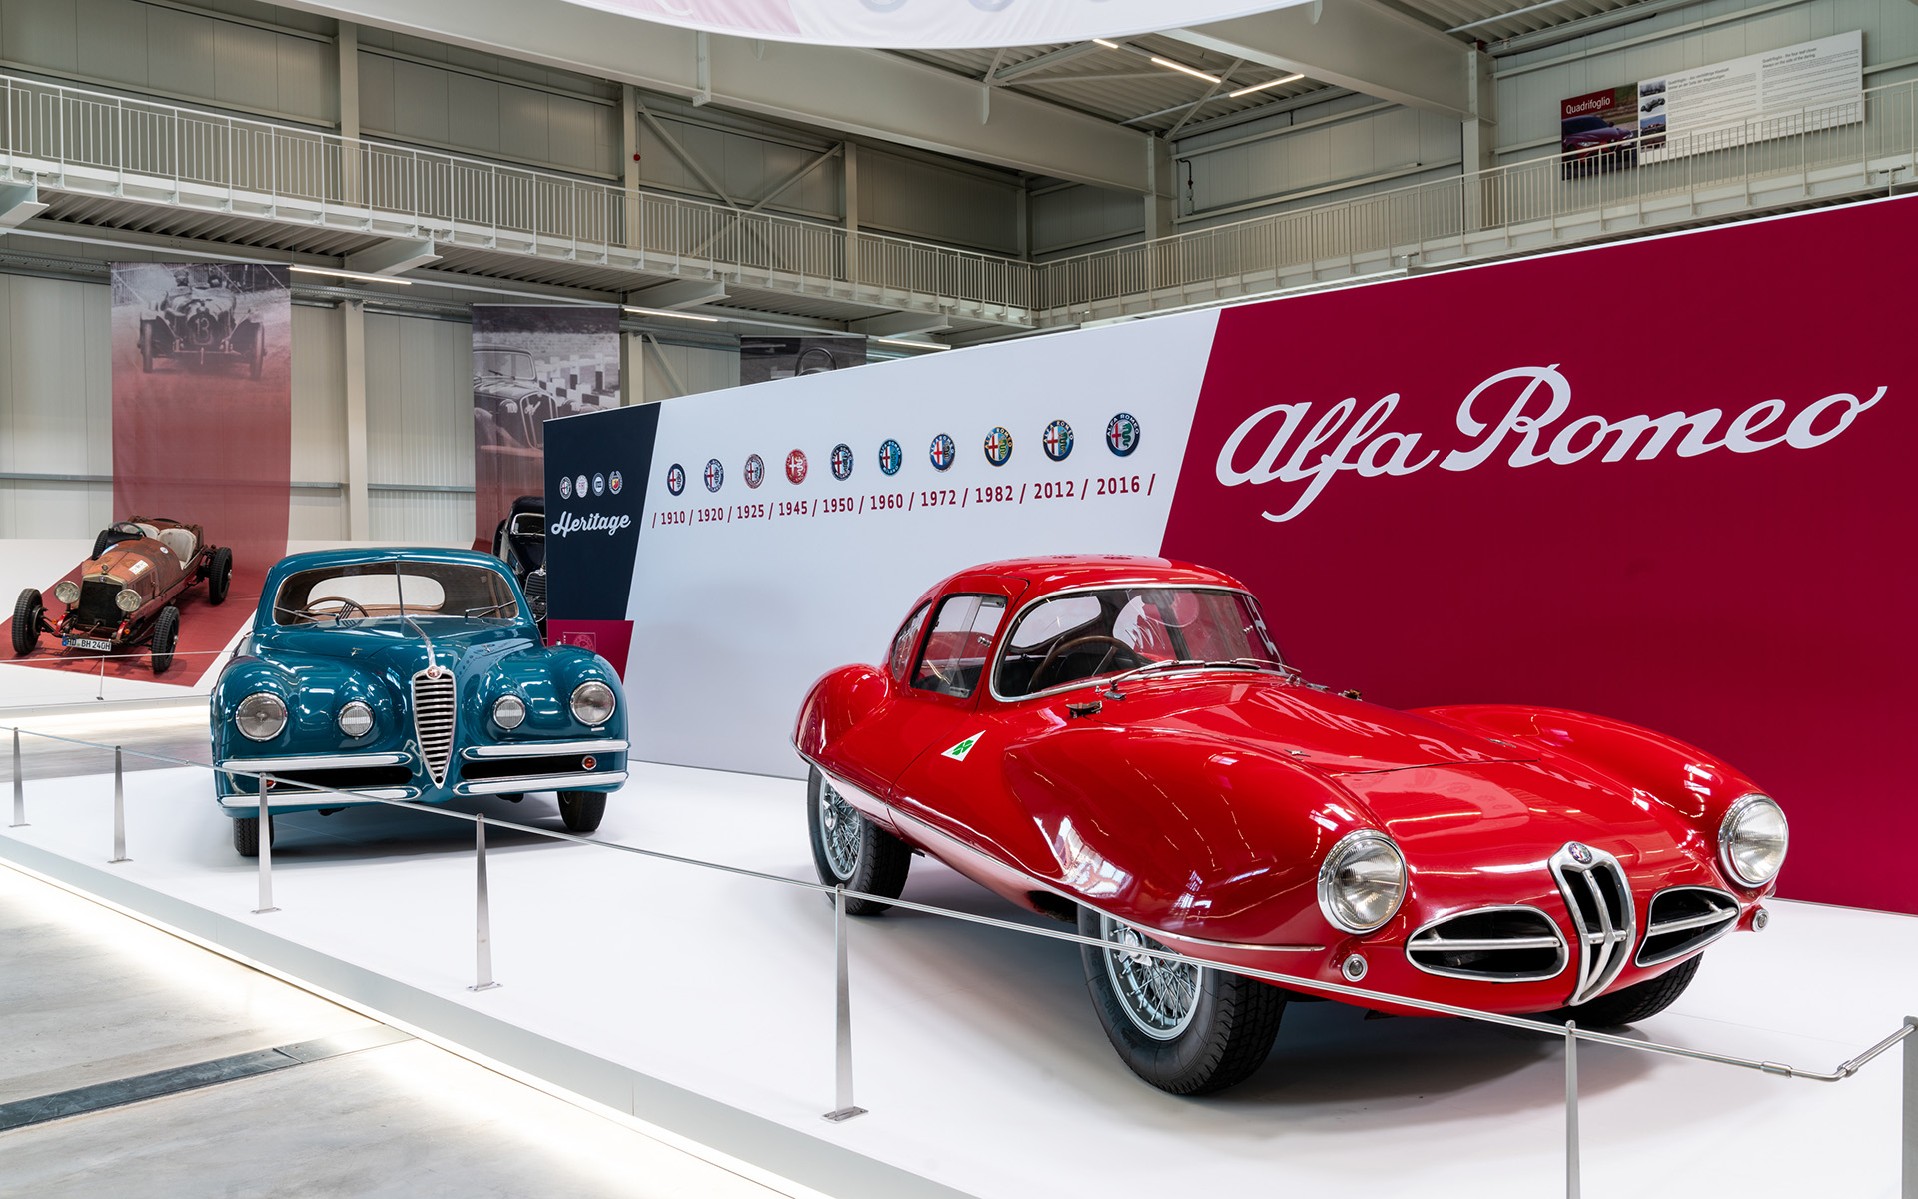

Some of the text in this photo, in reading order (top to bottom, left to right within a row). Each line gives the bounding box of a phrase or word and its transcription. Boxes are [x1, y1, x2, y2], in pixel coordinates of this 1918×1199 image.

[1566, 97, 1610, 114] Quadrifoglio
[195, 317, 209, 339] 13
[1216, 364, 1888, 522] Alfa Romeo
[661, 511, 685, 525] 1910
[698, 507, 723, 522] 1920
[737, 504, 764, 519] 1925
[779, 501, 807, 516] 1945
[823, 497, 854, 513] 1950
[870, 493, 903, 510] 1960
[921, 490, 956, 507] 1972
[976, 485, 1013, 503] 1982
[1034, 481, 1074, 499] 2012
[1097, 476, 1140, 495] 2016
[551, 511, 631, 538] Heritage
